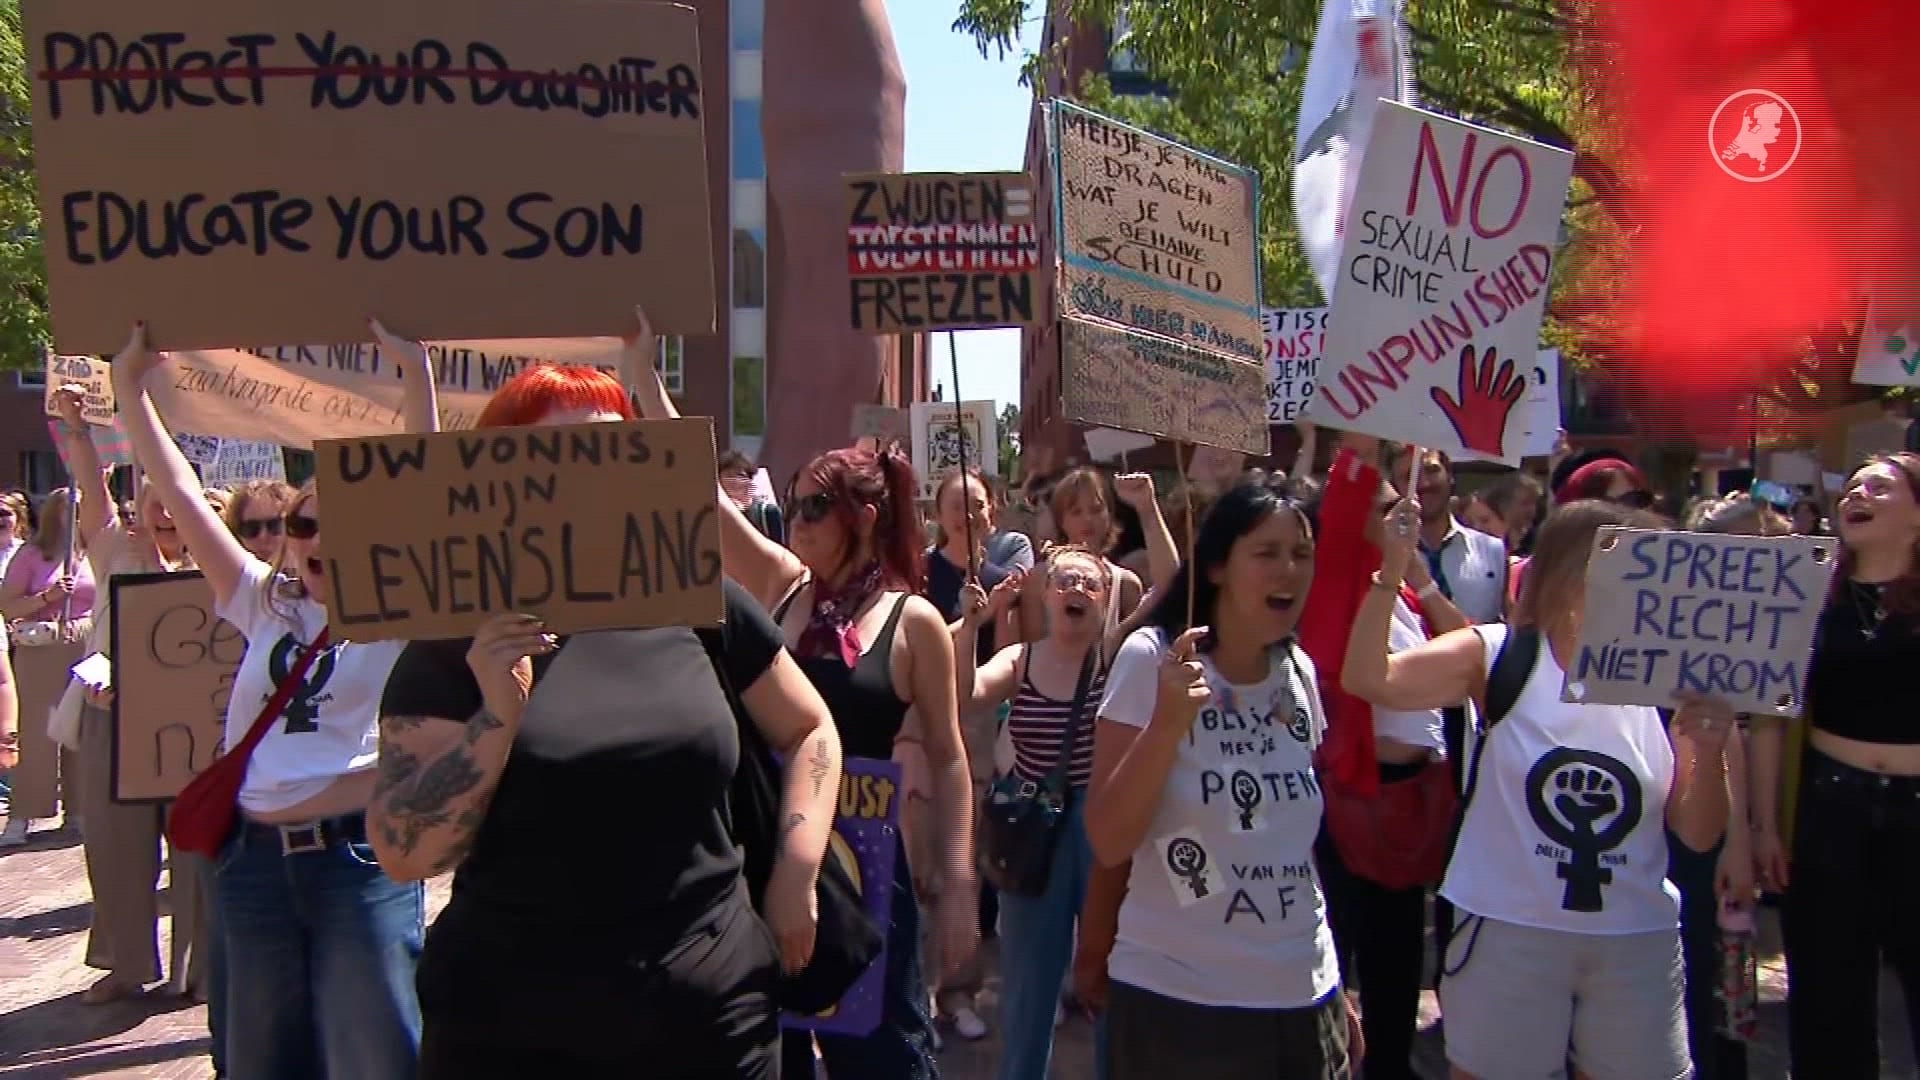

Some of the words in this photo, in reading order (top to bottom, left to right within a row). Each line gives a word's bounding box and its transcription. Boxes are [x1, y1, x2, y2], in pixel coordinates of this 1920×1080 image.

[1104, 157, 1212, 205] DRAGEN
[1155, 145, 1174, 167] JE
[1406, 121, 1531, 239] NO
[503, 192, 643, 260] SON
[1067, 180, 1116, 206] WAT
[1135, 200, 1159, 223] JE
[1178, 210, 1230, 246] WILT
[1361, 210, 1479, 273] SEXUAL
[848, 224, 1040, 271] TOESTEMMEN
[1086, 237, 1222, 293] SCHULD
[850, 272, 1033, 329] FREEZEN
[1351, 255, 1444, 303] CRIME
[1320, 244, 1552, 421] UNPUNISHED
[339, 438, 426, 482] UW
[458, 431, 676, 470] VONNIS,
[448, 474, 557, 527] MIJN
[330, 506, 722, 625] LEVENSLANG
[1622, 536, 1807, 600] SPREEK
[1633, 588, 1800, 650] RECHT
[1677, 650, 1801, 709] KROM
[1231, 863, 1275, 881] VAN
